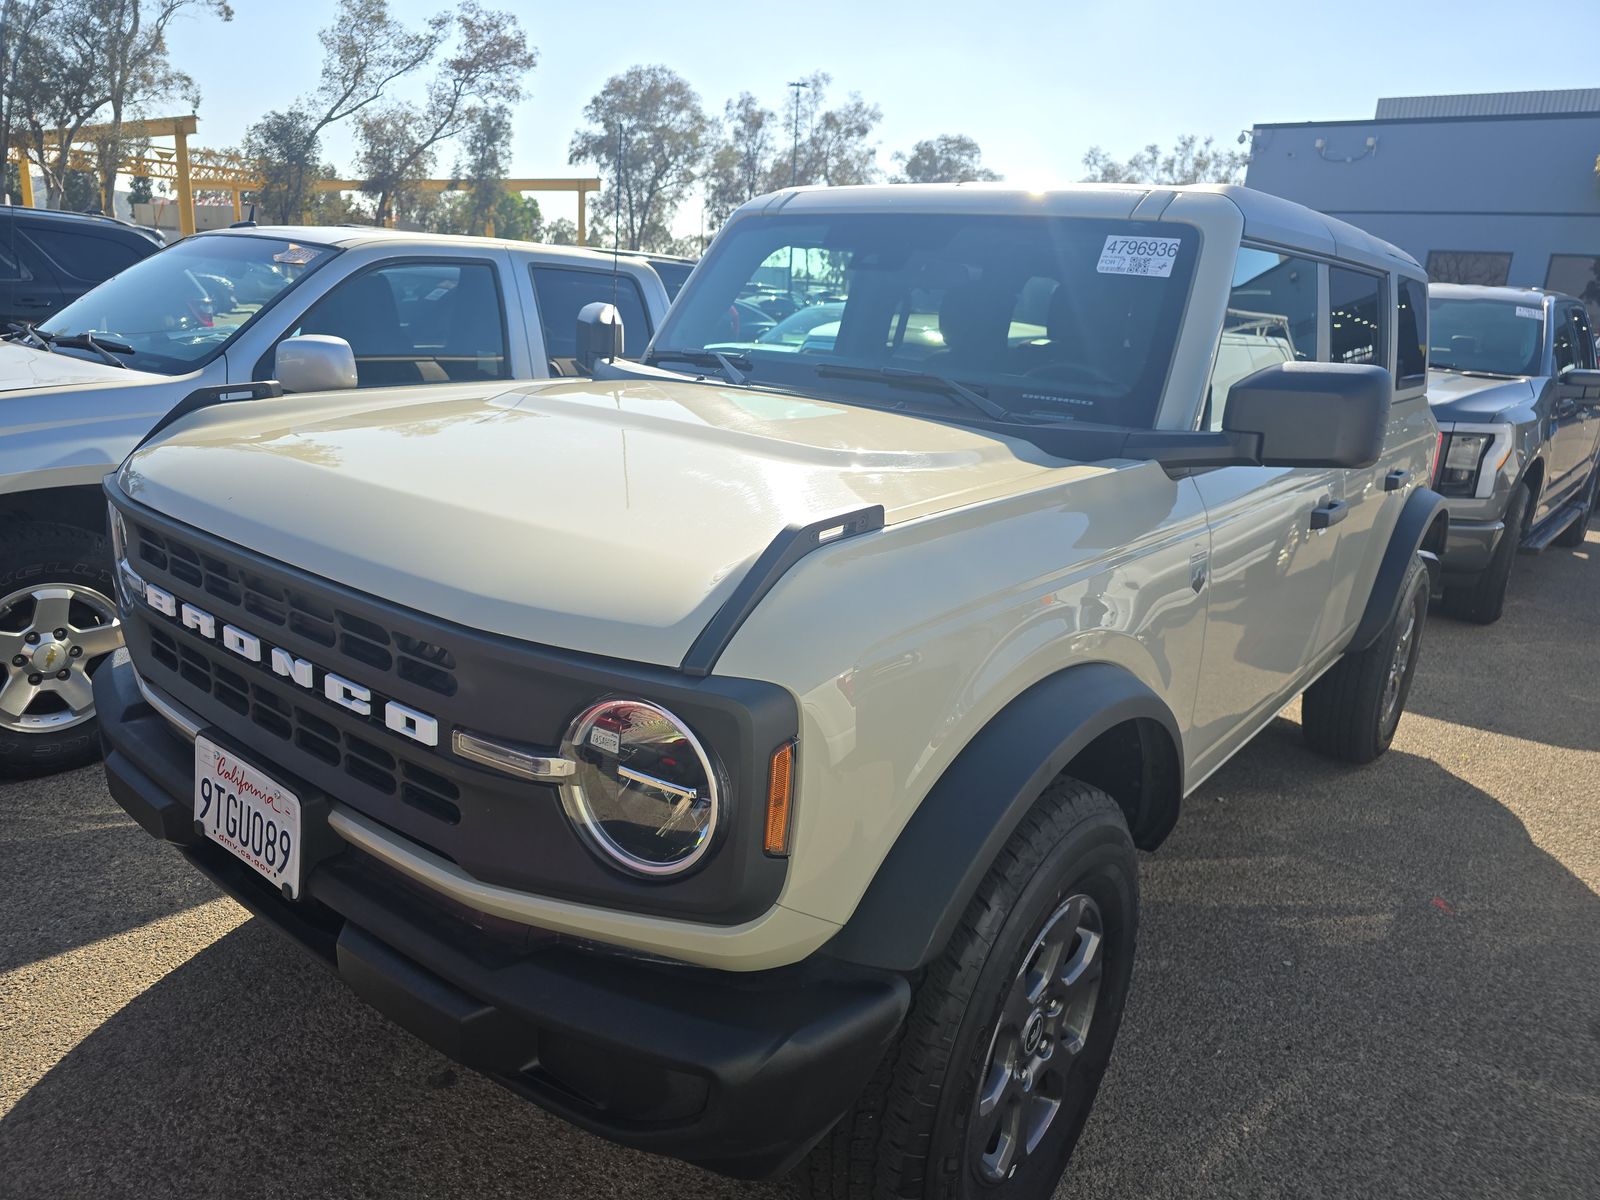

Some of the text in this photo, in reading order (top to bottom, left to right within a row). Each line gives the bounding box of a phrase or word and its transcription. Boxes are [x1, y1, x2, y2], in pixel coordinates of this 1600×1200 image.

[1107, 240, 1179, 258] 4796936
[146, 583, 439, 747] BRONCO
[216, 756, 281, 815] California
[200, 777, 291, 874] 9TGU089
[218, 834, 271, 875] dmv.ca.gov
